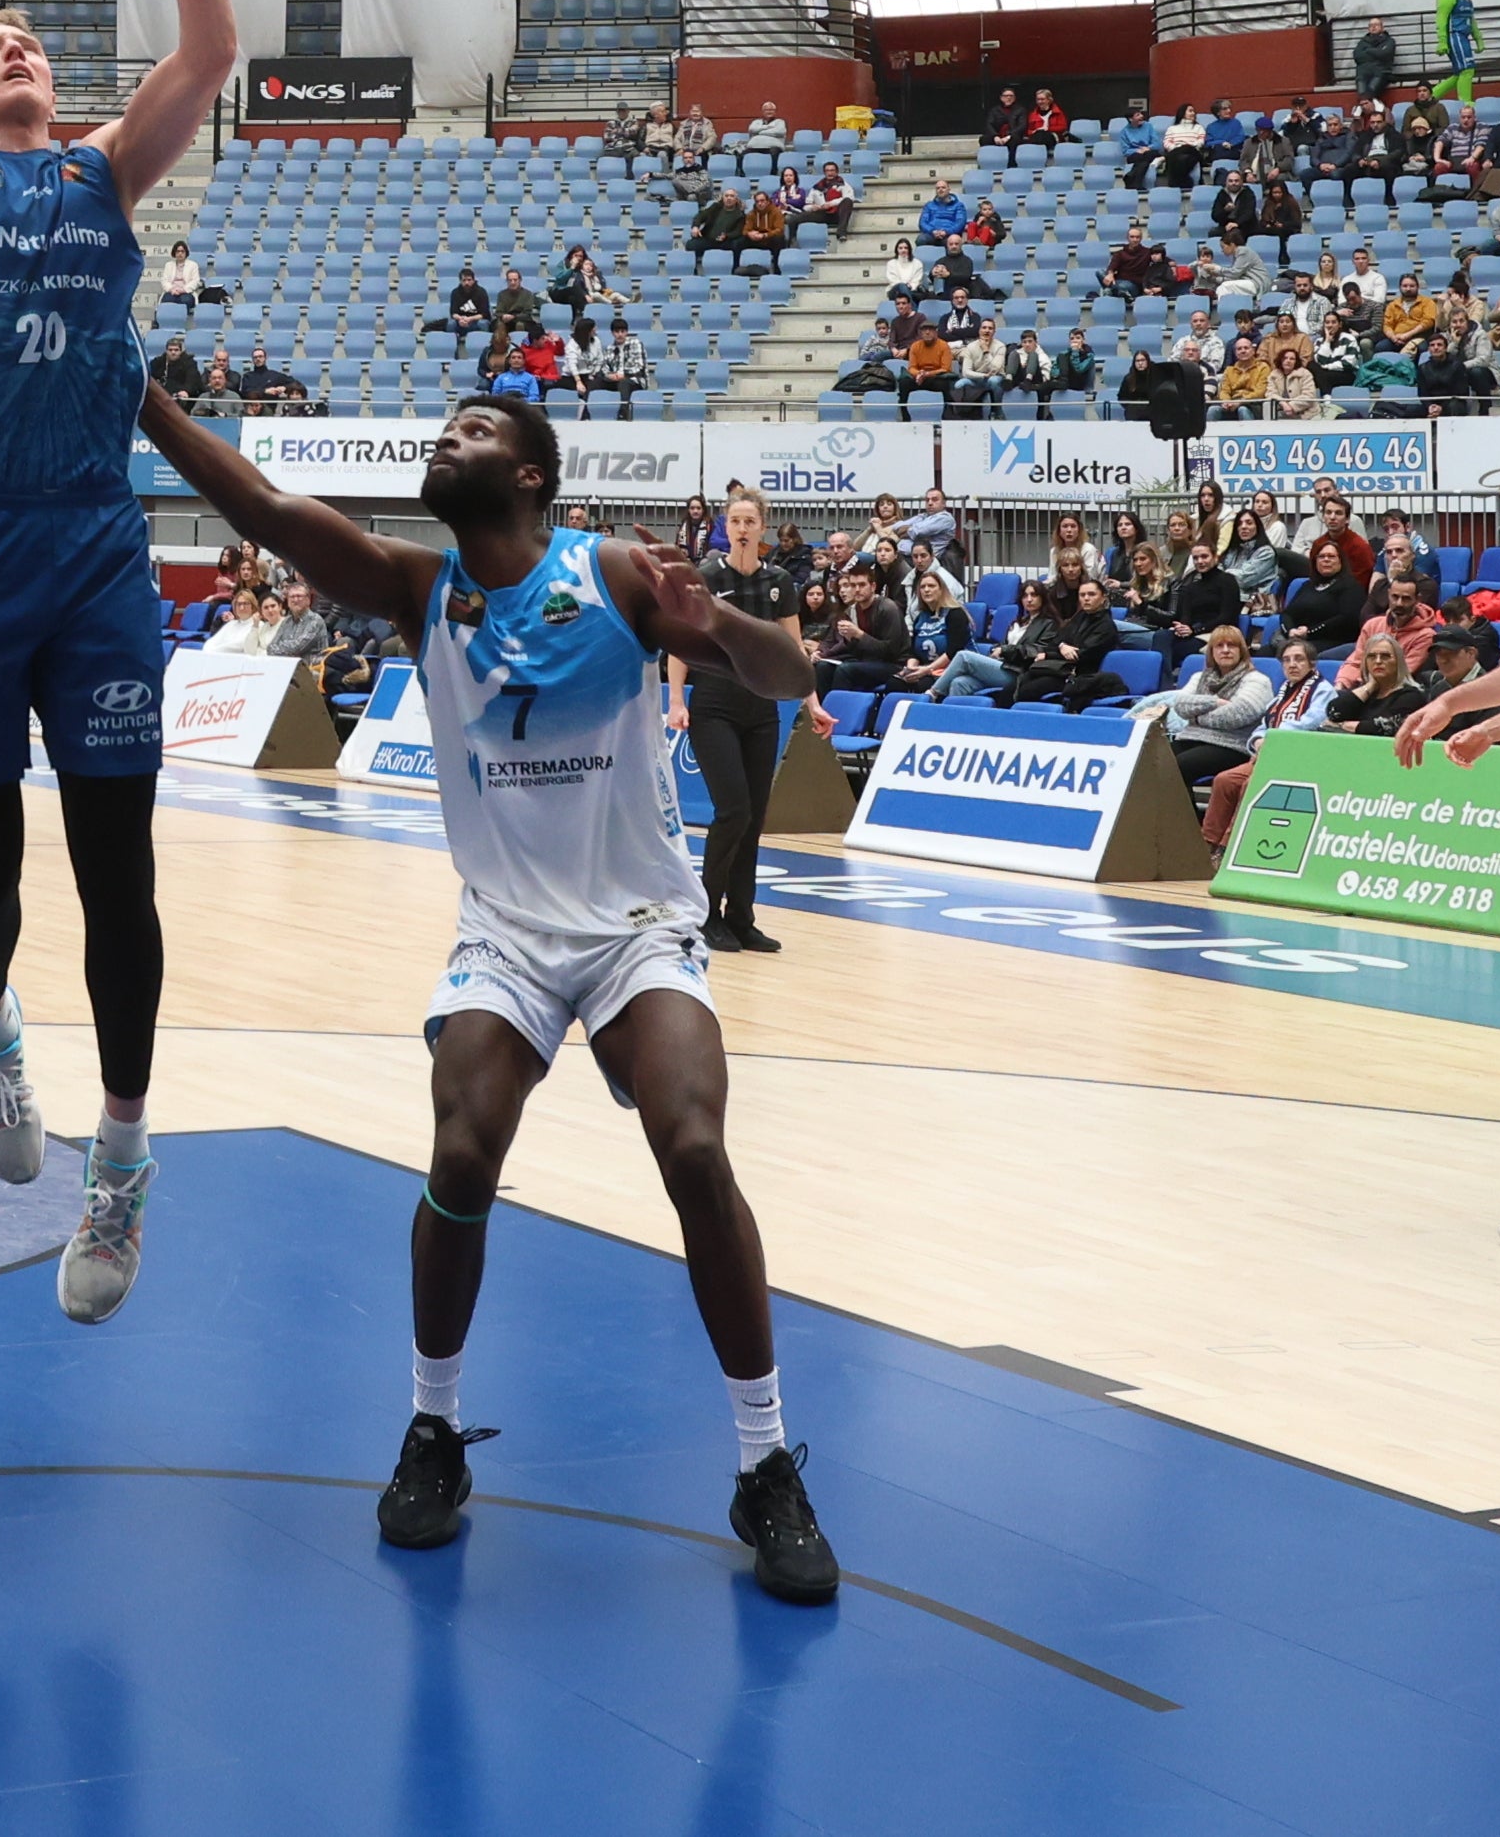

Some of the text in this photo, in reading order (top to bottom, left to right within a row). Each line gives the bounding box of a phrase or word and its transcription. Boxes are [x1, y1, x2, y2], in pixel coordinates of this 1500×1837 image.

[914, 49, 951, 67] BAR
[42, 274, 106, 293] KIROLAK
[15, 311, 67, 364] 20
[280, 464, 393, 475] TRANSPORTE Y DE
[1028, 438, 1132, 485] elektra
[1221, 435, 1424, 473] 943 46 46 46
[759, 463, 858, 494] aibak
[1223, 475, 1422, 492] TAXI DNOSTI
[88, 712, 159, 730] HYUNDAI
[175, 691, 247, 730] Krissia
[501, 685, 538, 740] 7
[487, 755, 614, 777] EXTREMADURA
[488, 774, 585, 788] NEW ENERGIES
[892, 742, 1105, 796] AGUINAMAR
[1326, 791, 1416, 822] alquiler
[1421, 798, 1454, 824] de
[1357, 876, 1493, 913] 658 497 818
